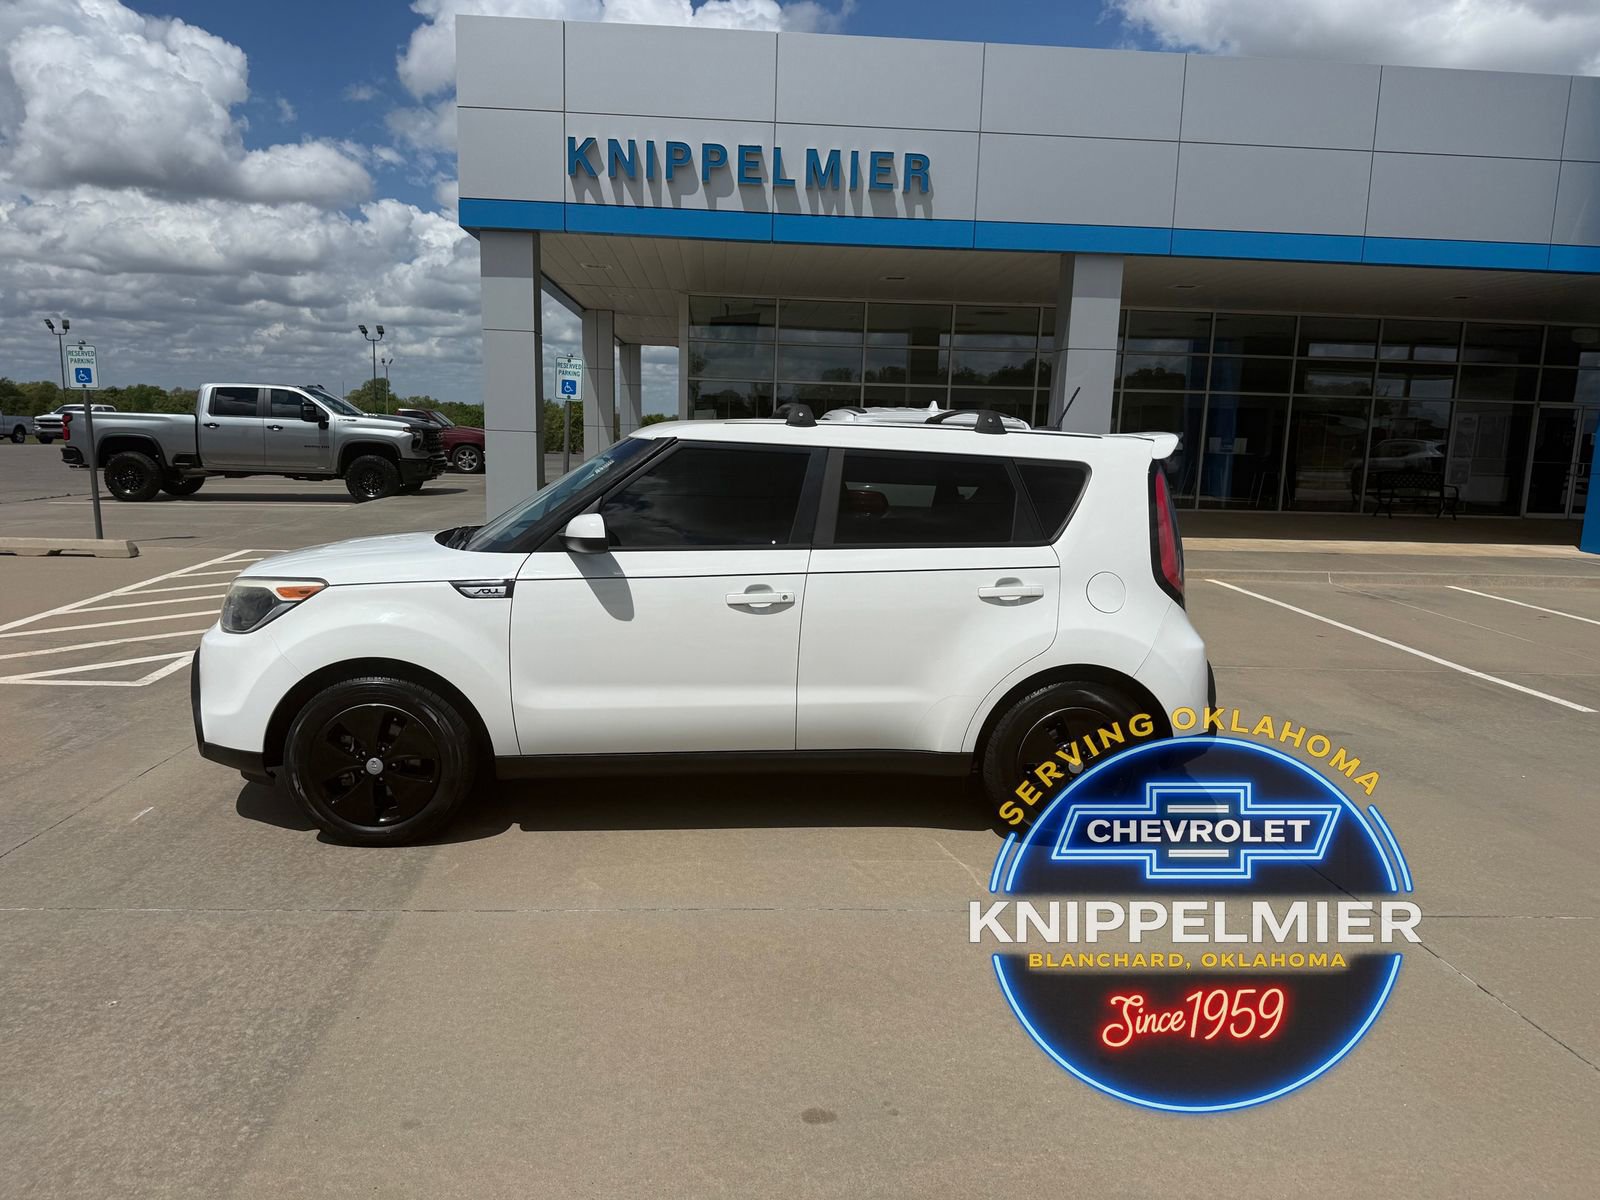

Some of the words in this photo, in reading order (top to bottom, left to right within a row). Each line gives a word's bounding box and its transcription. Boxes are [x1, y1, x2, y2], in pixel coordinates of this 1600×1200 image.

[567, 136, 931, 194] KNIPPELMIER
[557, 362, 582, 370] RESERVED
[559, 369, 581, 377] PARKING
